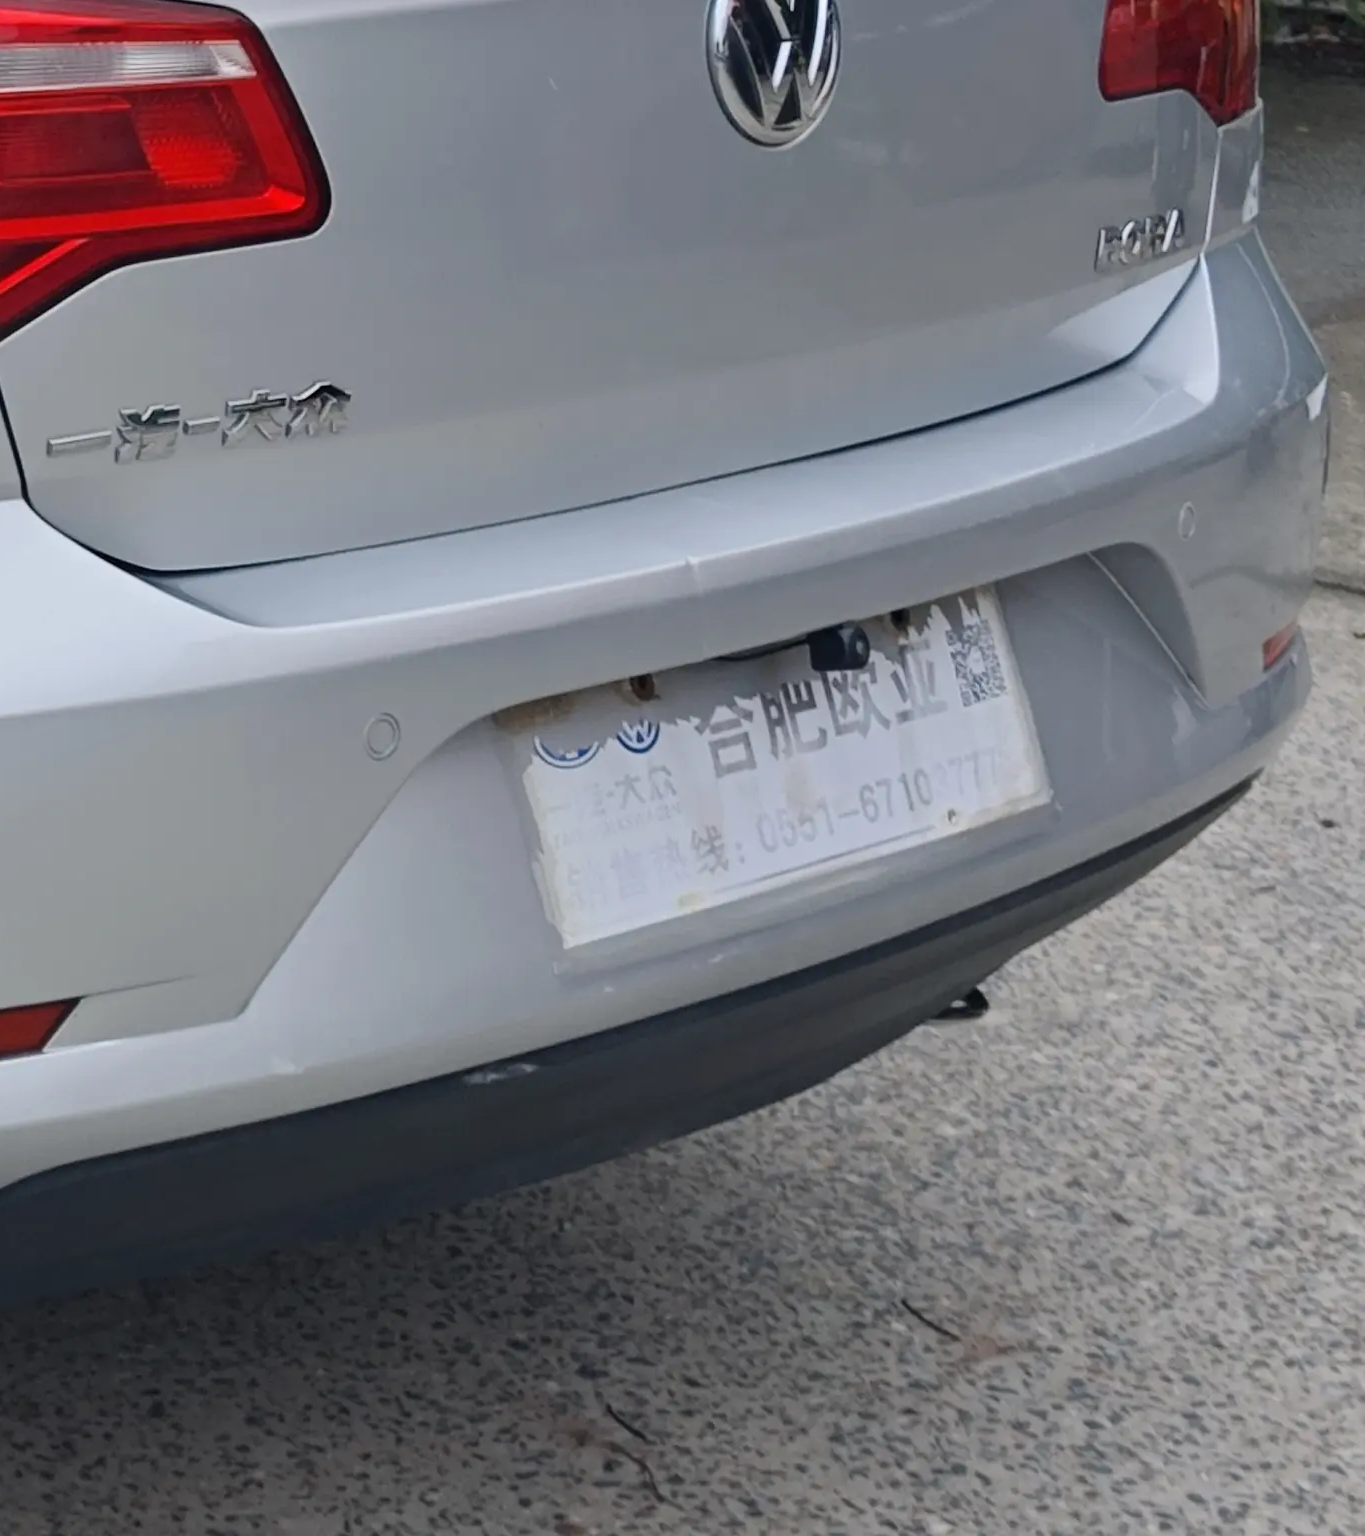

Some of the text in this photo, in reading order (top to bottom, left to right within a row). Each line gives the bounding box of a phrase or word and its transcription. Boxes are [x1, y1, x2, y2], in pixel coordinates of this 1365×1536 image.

[46, 380, 353, 464] 一汽-大众
[694, 638, 949, 778] 合肥欧亚
